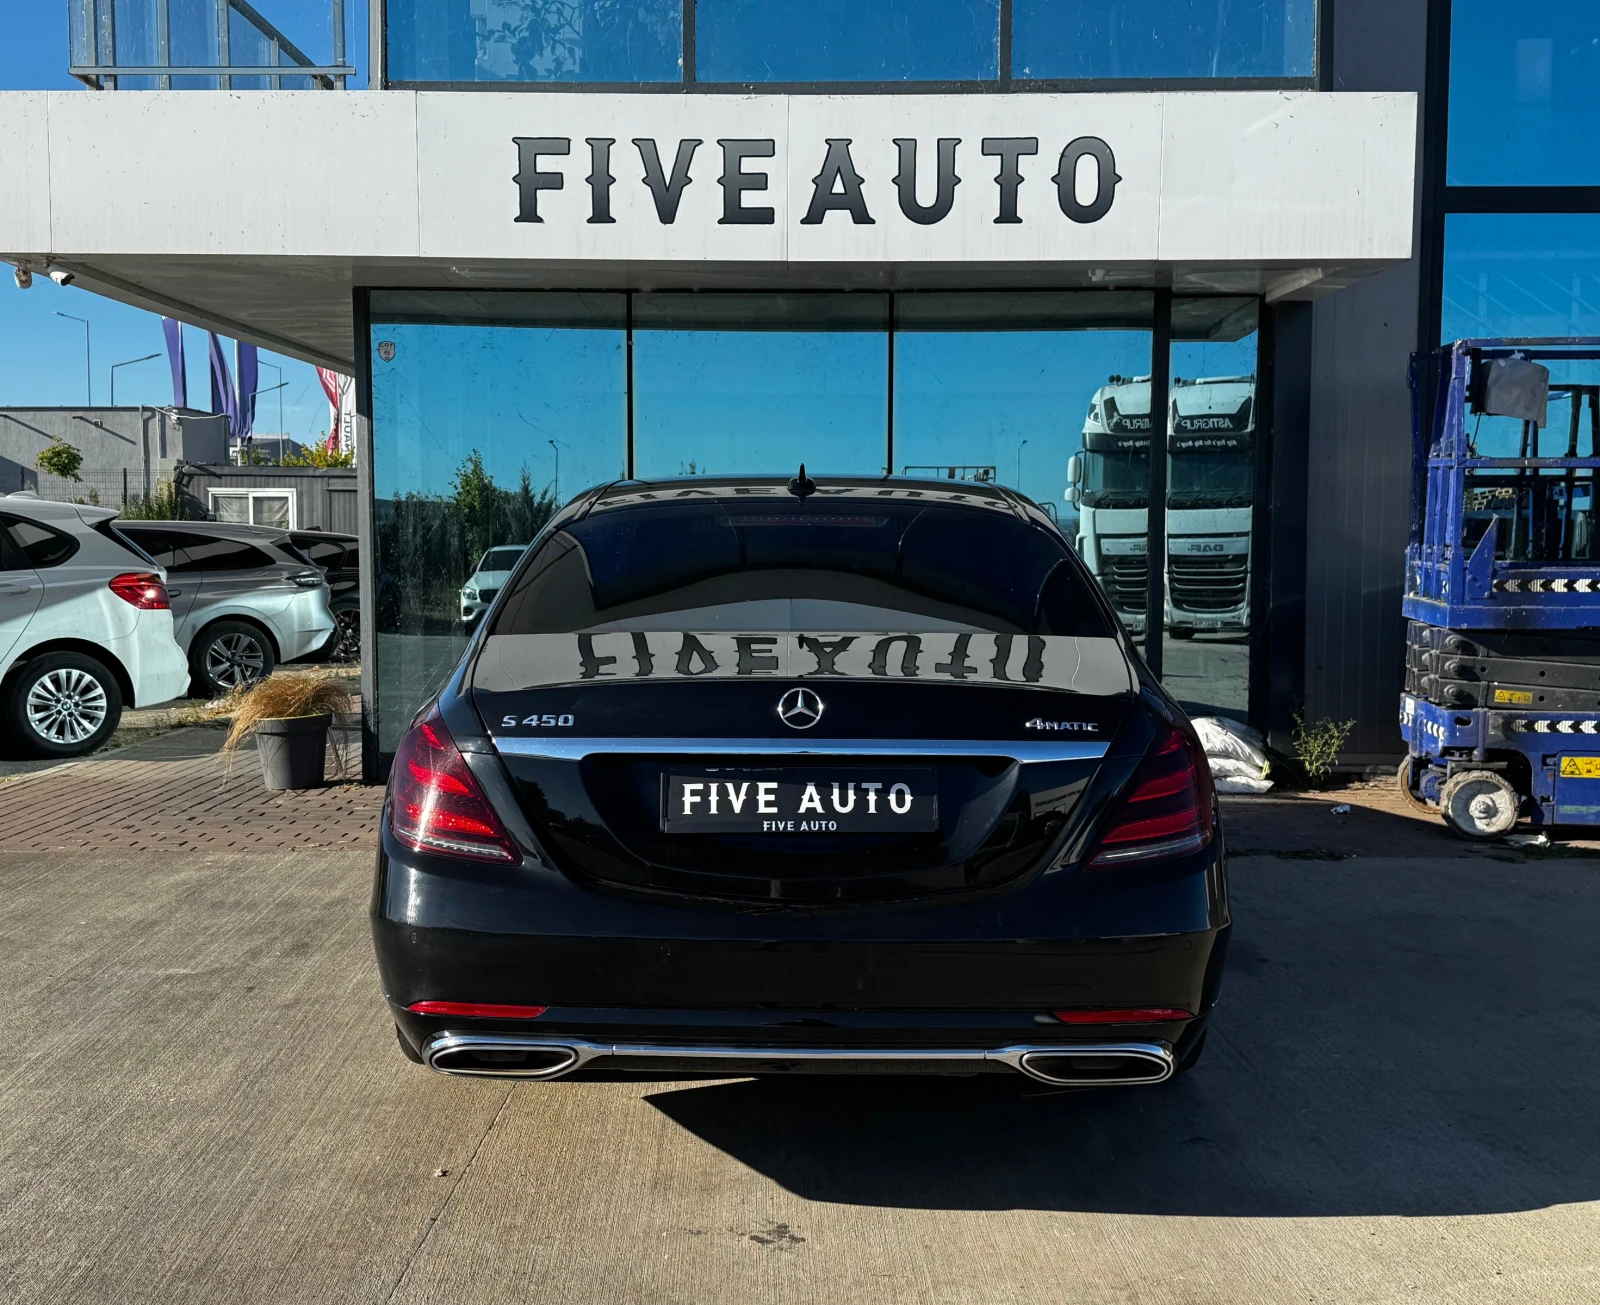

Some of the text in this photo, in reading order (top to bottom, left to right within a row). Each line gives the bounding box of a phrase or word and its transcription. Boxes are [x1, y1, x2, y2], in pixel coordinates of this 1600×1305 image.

[512, 136, 1123, 226] FIVE AUTO
[501, 714, 575, 727] S 450
[1025, 717, 1099, 732] 4MATIC
[681, 782, 914, 815] FIVE AUTO
[762, 820, 838, 831] FIVE AUTO
